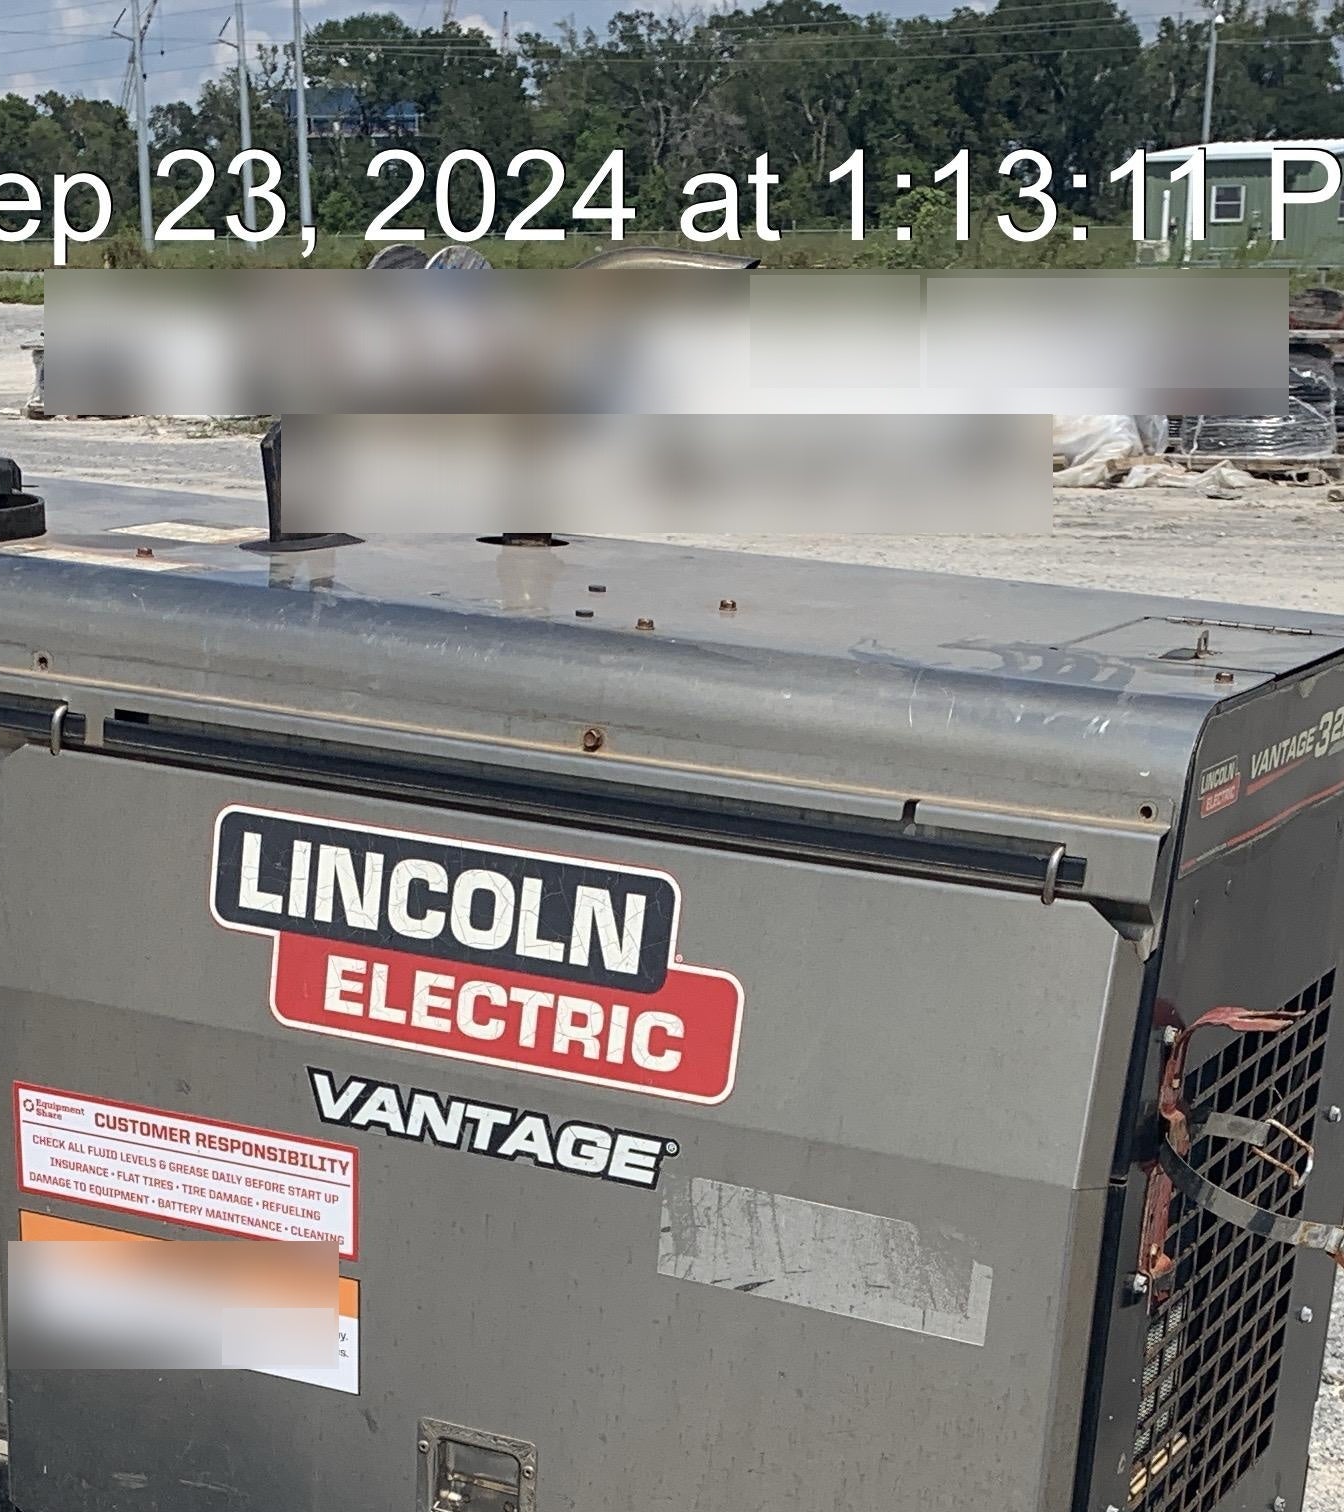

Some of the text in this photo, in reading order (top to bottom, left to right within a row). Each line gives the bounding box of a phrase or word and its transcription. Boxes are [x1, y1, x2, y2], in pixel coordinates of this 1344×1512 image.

[1200, 761, 1236, 794] LINCOLN
[1250, 726, 1318, 779] VANTAGE
[237, 831, 647, 976] LINCOLN
[323, 954, 686, 1073] ELECTRIC
[35, 1098, 85, 1116] Equipment
[36, 1109, 63, 1121] Share
[311, 1070, 663, 1185] VANTAGE
[32, 1134, 339, 1204] CHECK ALL FLUID LEVELS & GREASE DAILY BEFORE START UP
[94, 1112, 350, 1176] CUSTOMER RESPONSIBILITY
[29, 1171, 345, 1245] DAMAGE TO EQUIPMENT BATTERY MAINTENANCE CLEANING
[49, 1156, 321, 1221] INSURANCE FLAT TIRES TIRE DAMAGE REFUELING
